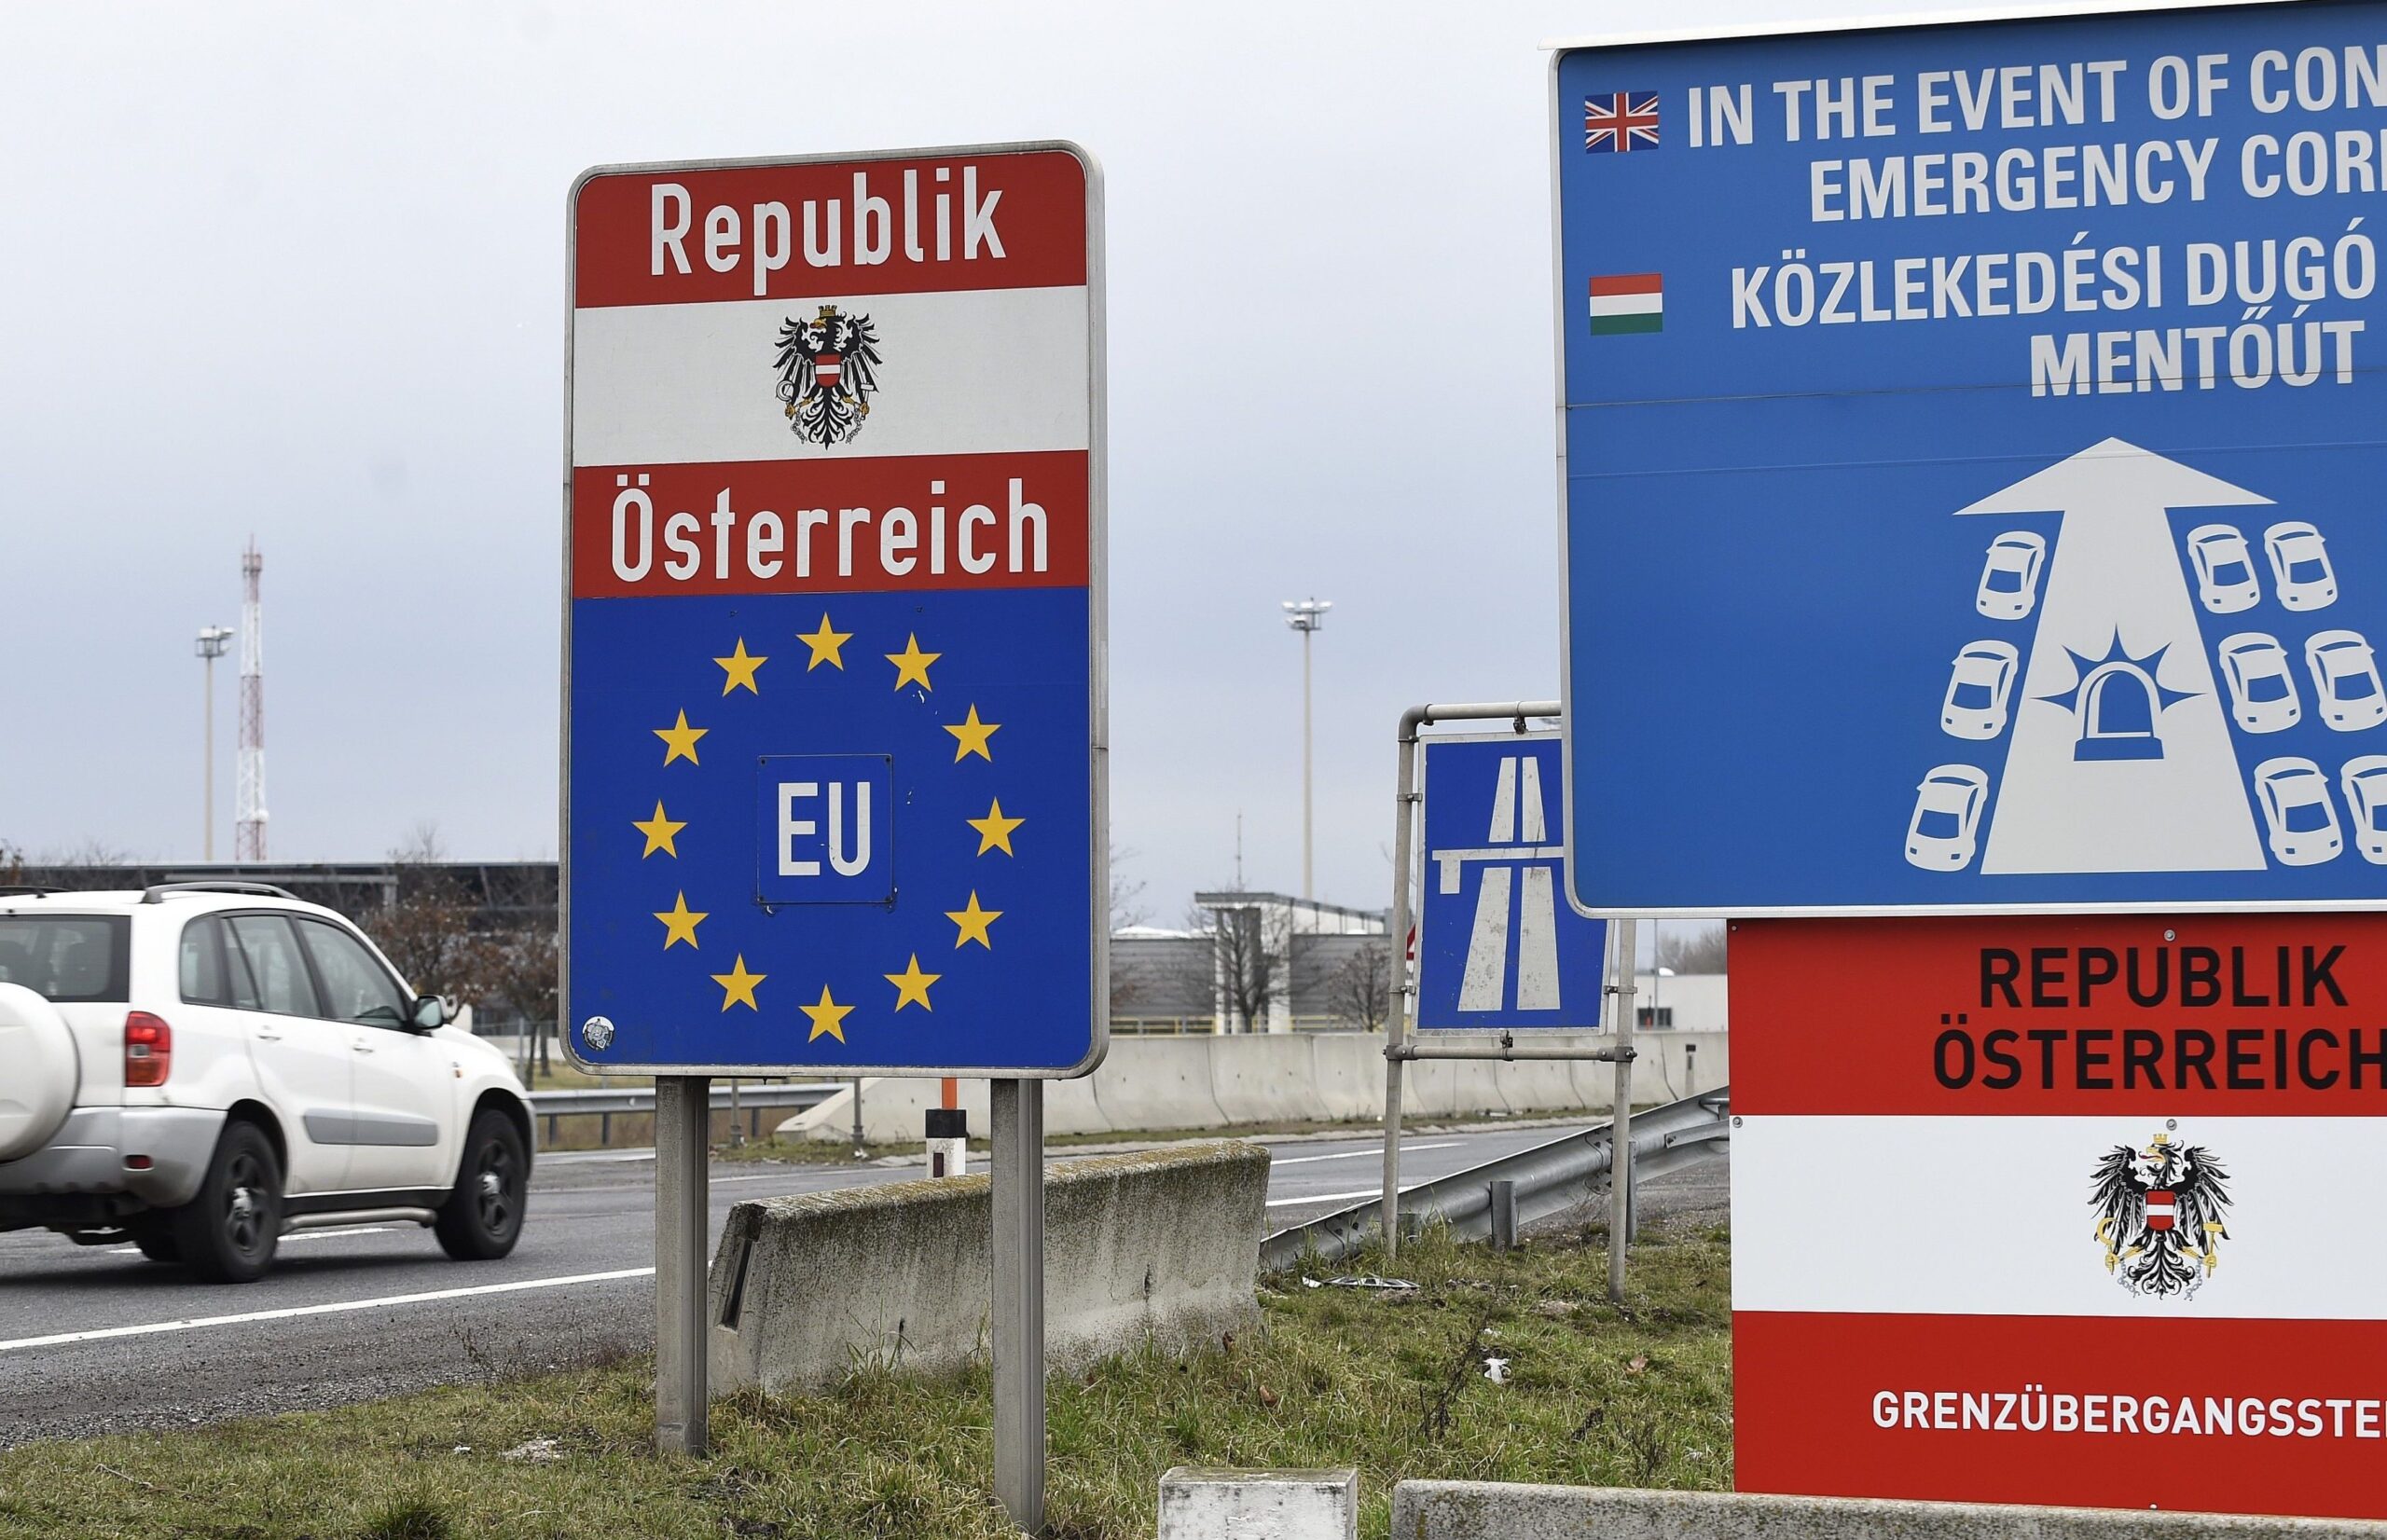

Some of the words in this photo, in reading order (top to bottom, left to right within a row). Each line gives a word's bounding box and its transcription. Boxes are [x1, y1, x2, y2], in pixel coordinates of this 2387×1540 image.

[1689, 84, 1753, 148] IN
[1773, 75, 1897, 142] THE
[1918, 60, 2127, 134] EVENT
[2148, 53, 2228, 120] OF
[2250, 44, 2387, 114] CON
[1810, 137, 2219, 223] EMERGENCY
[2241, 128, 2387, 199] COR
[651, 165, 1007, 296] Republik
[1732, 230, 2161, 329] KÖZLEKEDÉSI
[2187, 216, 2376, 307] DUGÓ
[2030, 304, 2366, 397] MENTŐÚT
[612, 474, 1048, 583] Österreich
[778, 781, 871, 876] EU
[1980, 944, 2349, 1008] REPUBLIK
[1934, 1013, 2387, 1091] ÖSTERREICH
[1872, 1383, 2387, 1438] GRENZÜBERGANGSSTE
